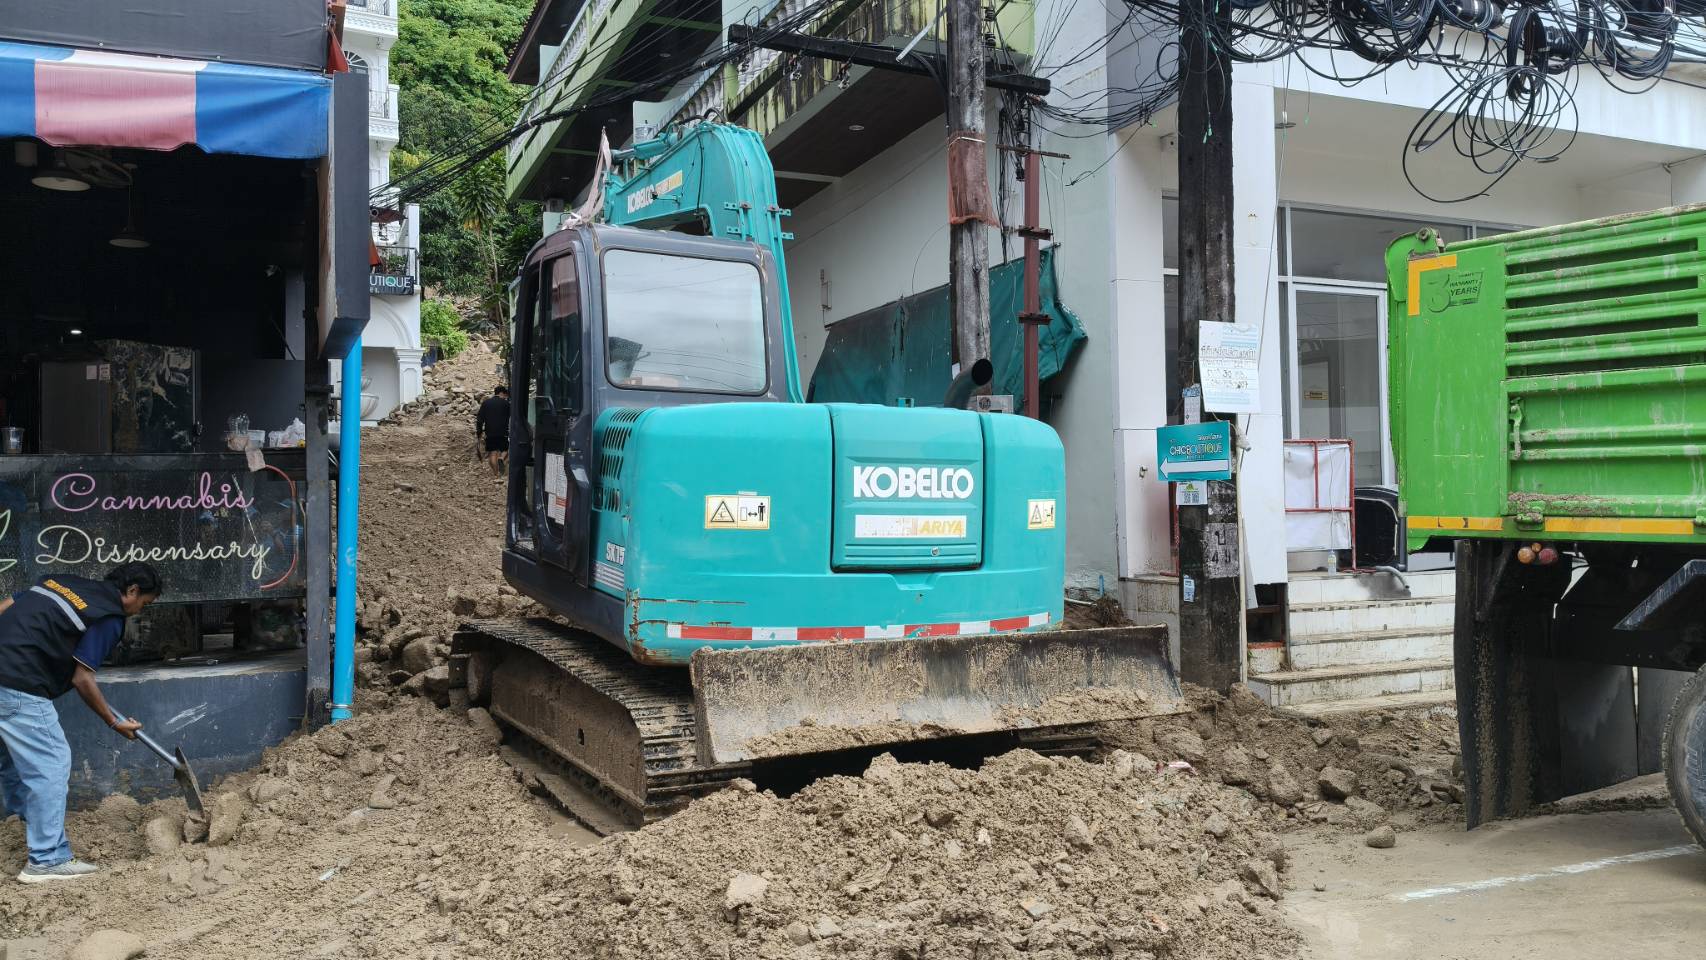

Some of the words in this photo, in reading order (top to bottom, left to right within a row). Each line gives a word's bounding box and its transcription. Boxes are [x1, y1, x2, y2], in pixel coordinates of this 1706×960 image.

[1450, 286, 1478, 297] YEARS
[51, 472, 255, 512] Cannabis
[853, 465, 974, 500] KOBELCO
[919, 520, 963, 536] ARIYA
[35, 524, 271, 580] Dispensary
